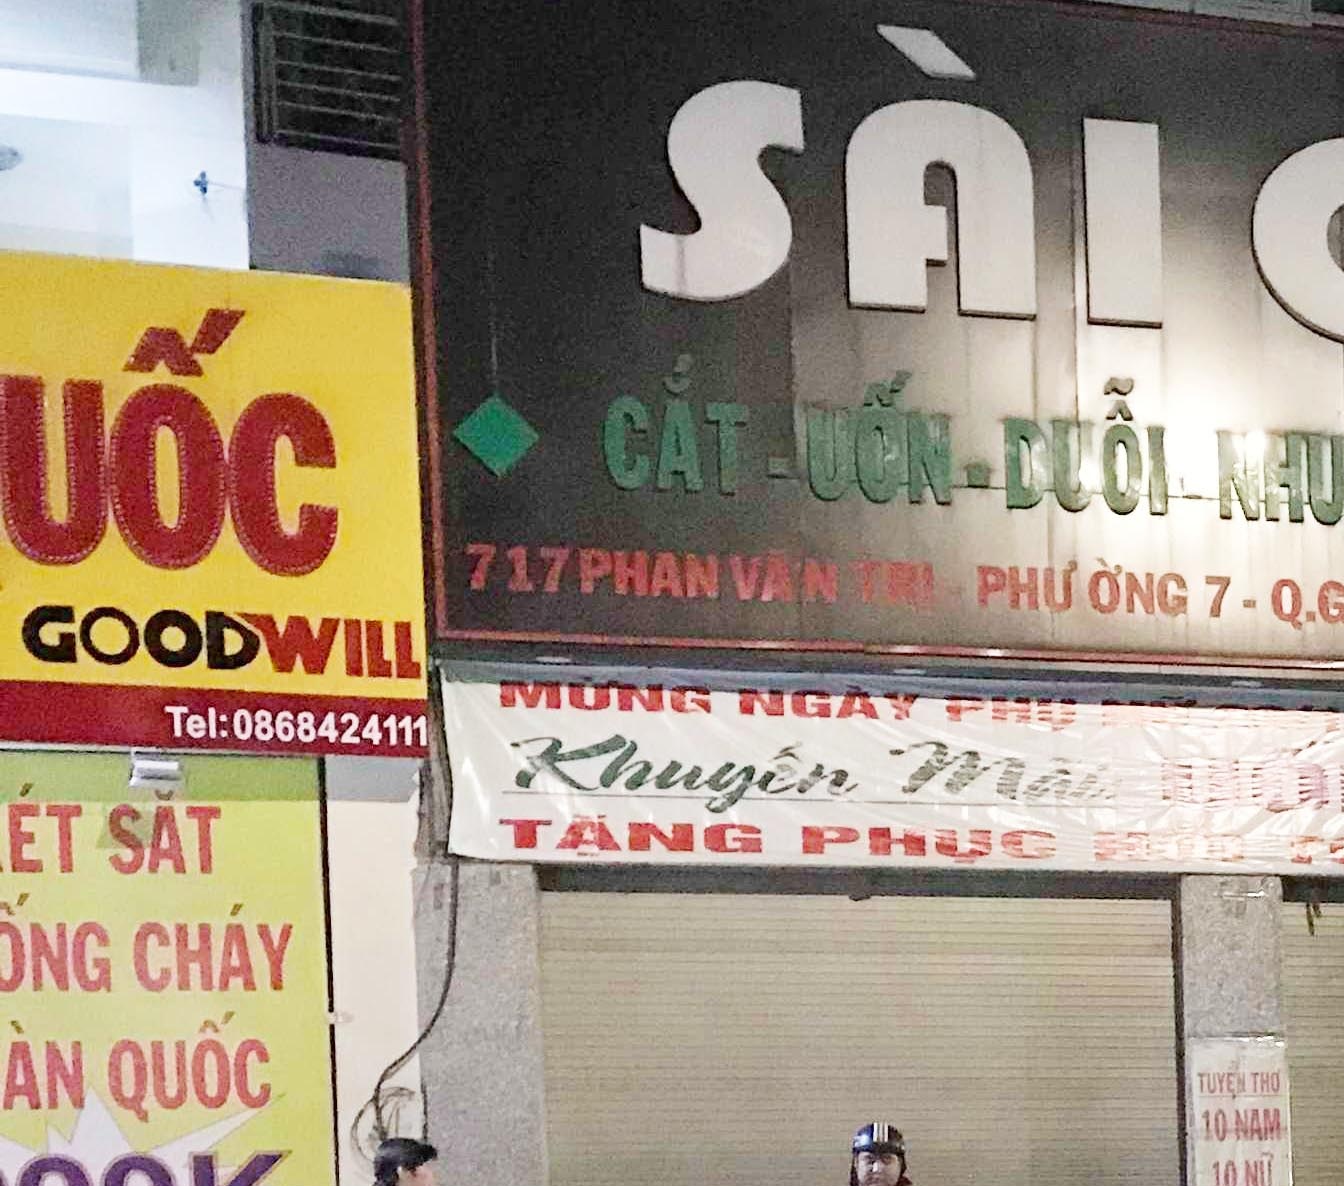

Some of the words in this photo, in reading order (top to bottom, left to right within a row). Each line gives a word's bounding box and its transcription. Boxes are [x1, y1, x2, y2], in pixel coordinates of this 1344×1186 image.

[640, 25, 1163, 329] SÀI
[0, 308, 338, 577] UỐC
[805, 369, 952, 506] UỐN
[1001, 376, 1169, 516] DUỖI
[464, 543, 569, 593] 717
[579, 547, 720, 599] PHAN
[1204, 575, 1232, 619] 7
[22, 604, 421, 680] GOODWILL
[0, 781, 83, 875] ÉT
[133, 903, 294, 993] CHÁY
[107, 1011, 272, 1123] QUỐC
[1202, 1108, 1228, 1143] 10
[1234, 1108, 1282, 1143] NAM
